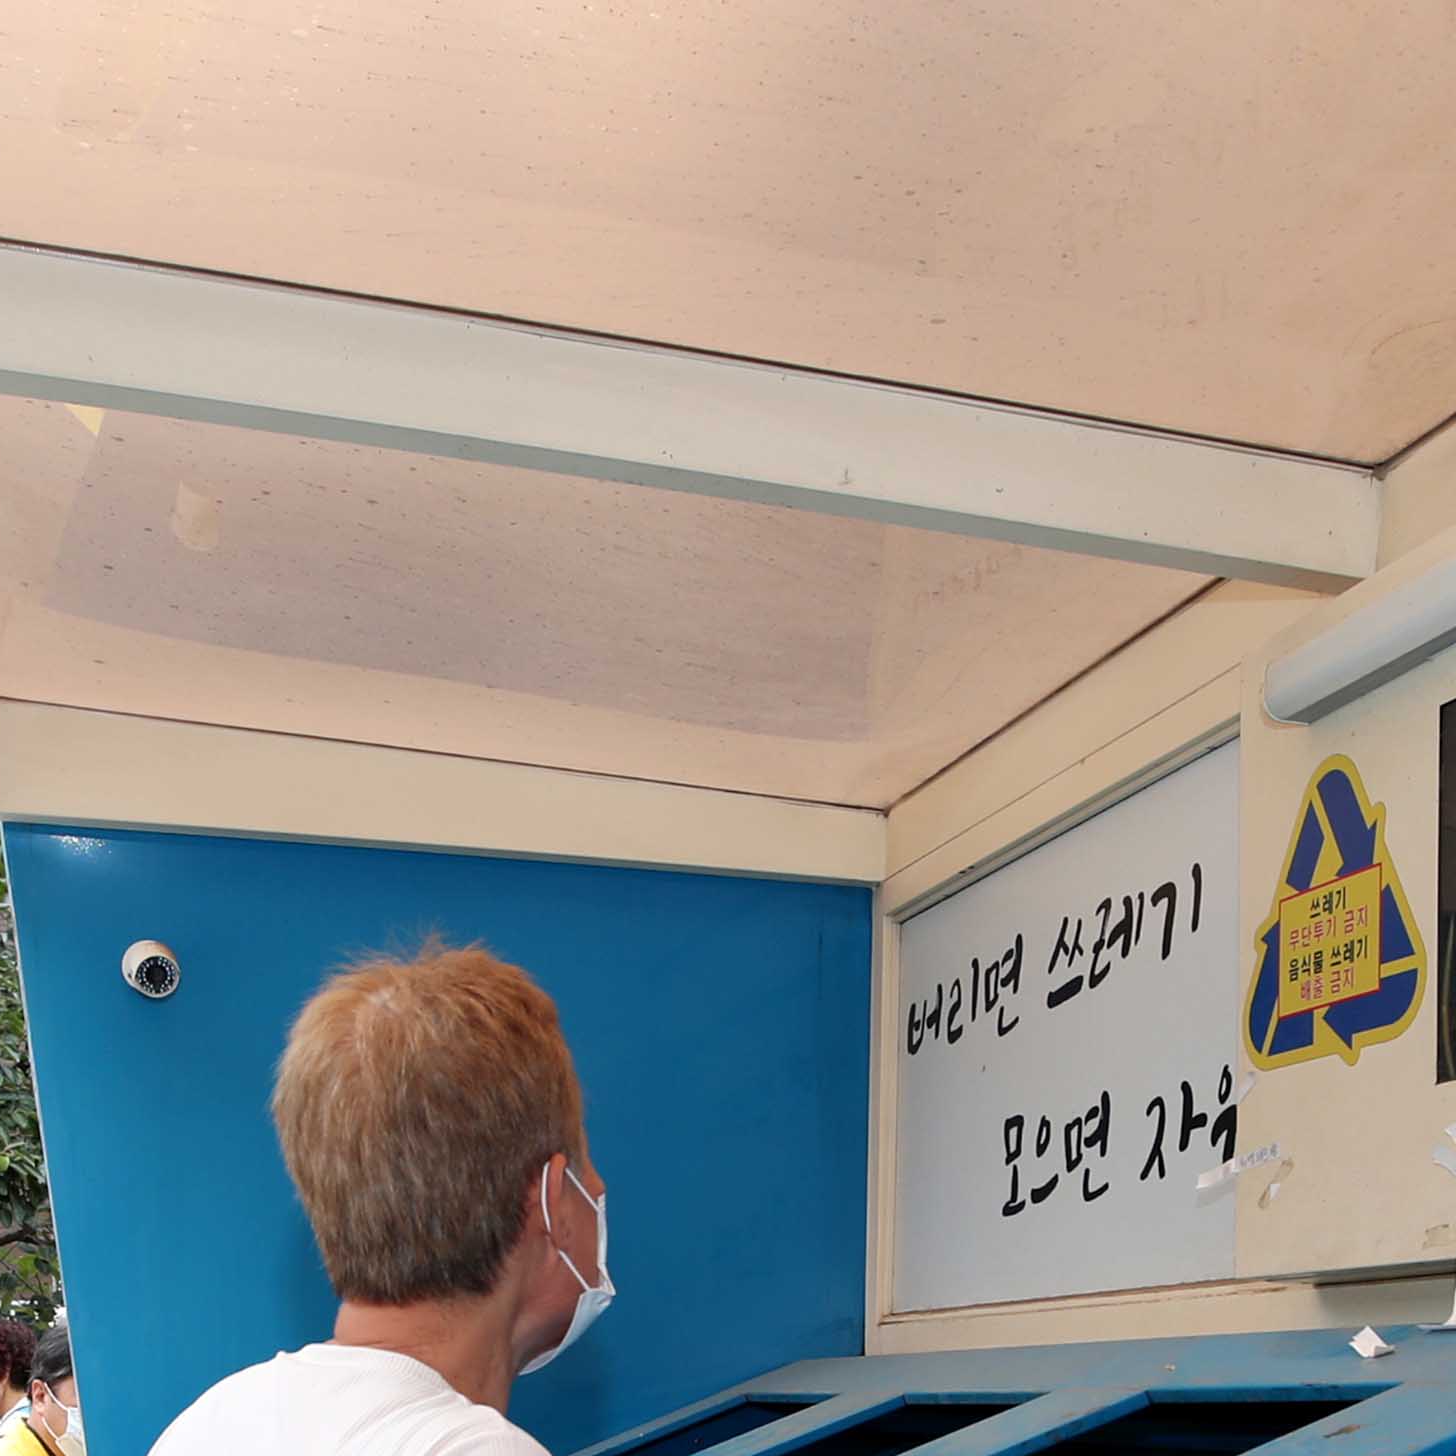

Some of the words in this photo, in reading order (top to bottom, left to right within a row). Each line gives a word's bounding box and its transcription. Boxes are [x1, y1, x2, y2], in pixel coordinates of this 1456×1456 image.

[1310, 887, 1346, 919] 쓰레기
[1289, 917, 1337, 951] 무단투기
[1344, 905, 1368, 935] 금지
[908, 933, 1023, 1056] 버리면
[1047, 862, 1203, 1009] 쓰레기
[1289, 950, 1323, 982] 음식물
[1330, 936, 1368, 967] 쓰레기
[1300, 975, 1325, 1000] 배출
[1330, 967, 1354, 994] 금지
[1002, 1090, 1111, 1217] 모으면
